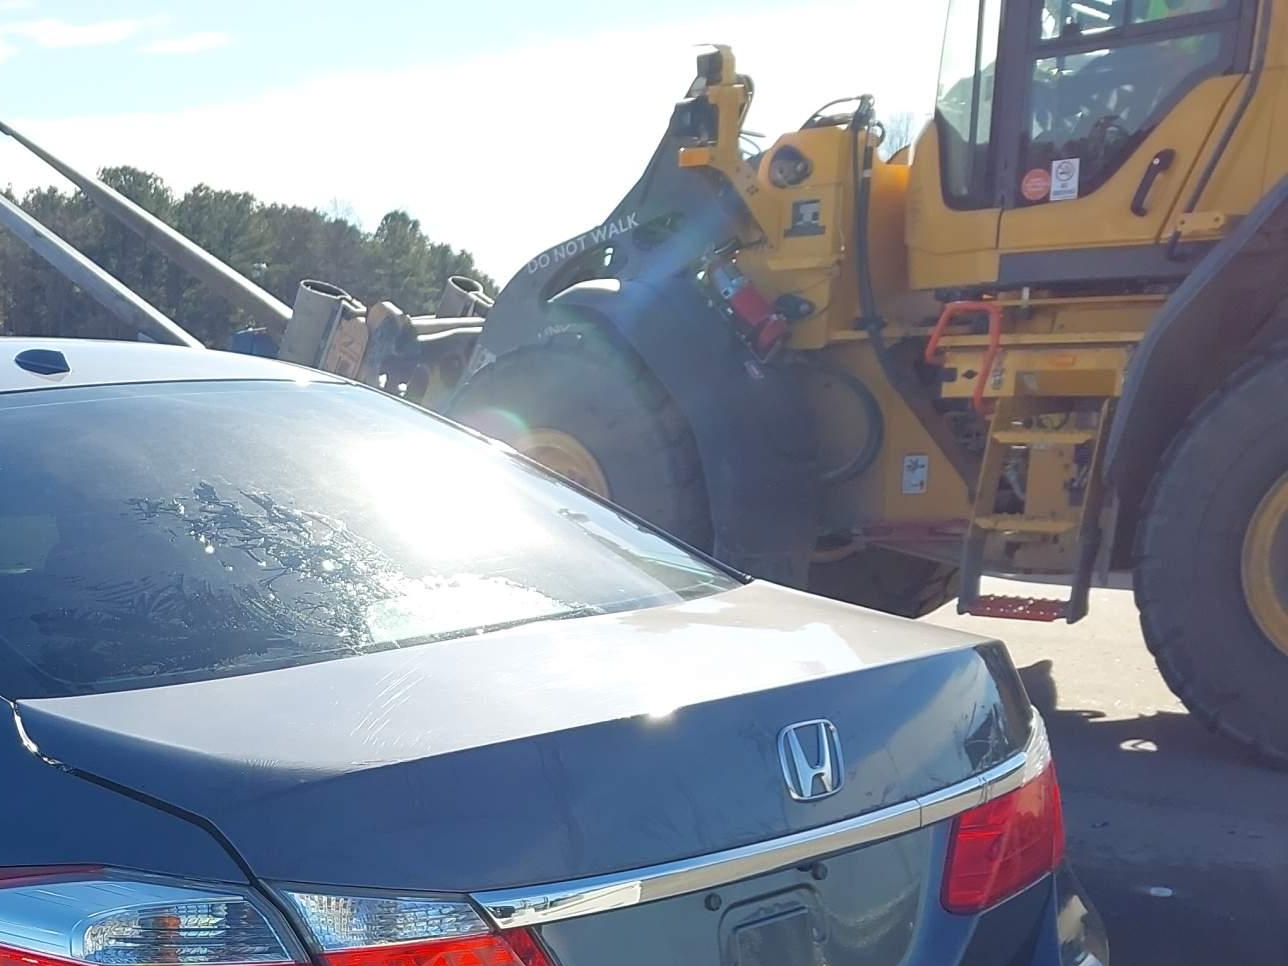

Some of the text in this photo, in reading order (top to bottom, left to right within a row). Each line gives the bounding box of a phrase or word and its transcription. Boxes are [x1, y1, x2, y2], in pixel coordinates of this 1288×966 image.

[527, 212, 639, 274] DO NOT WALK
